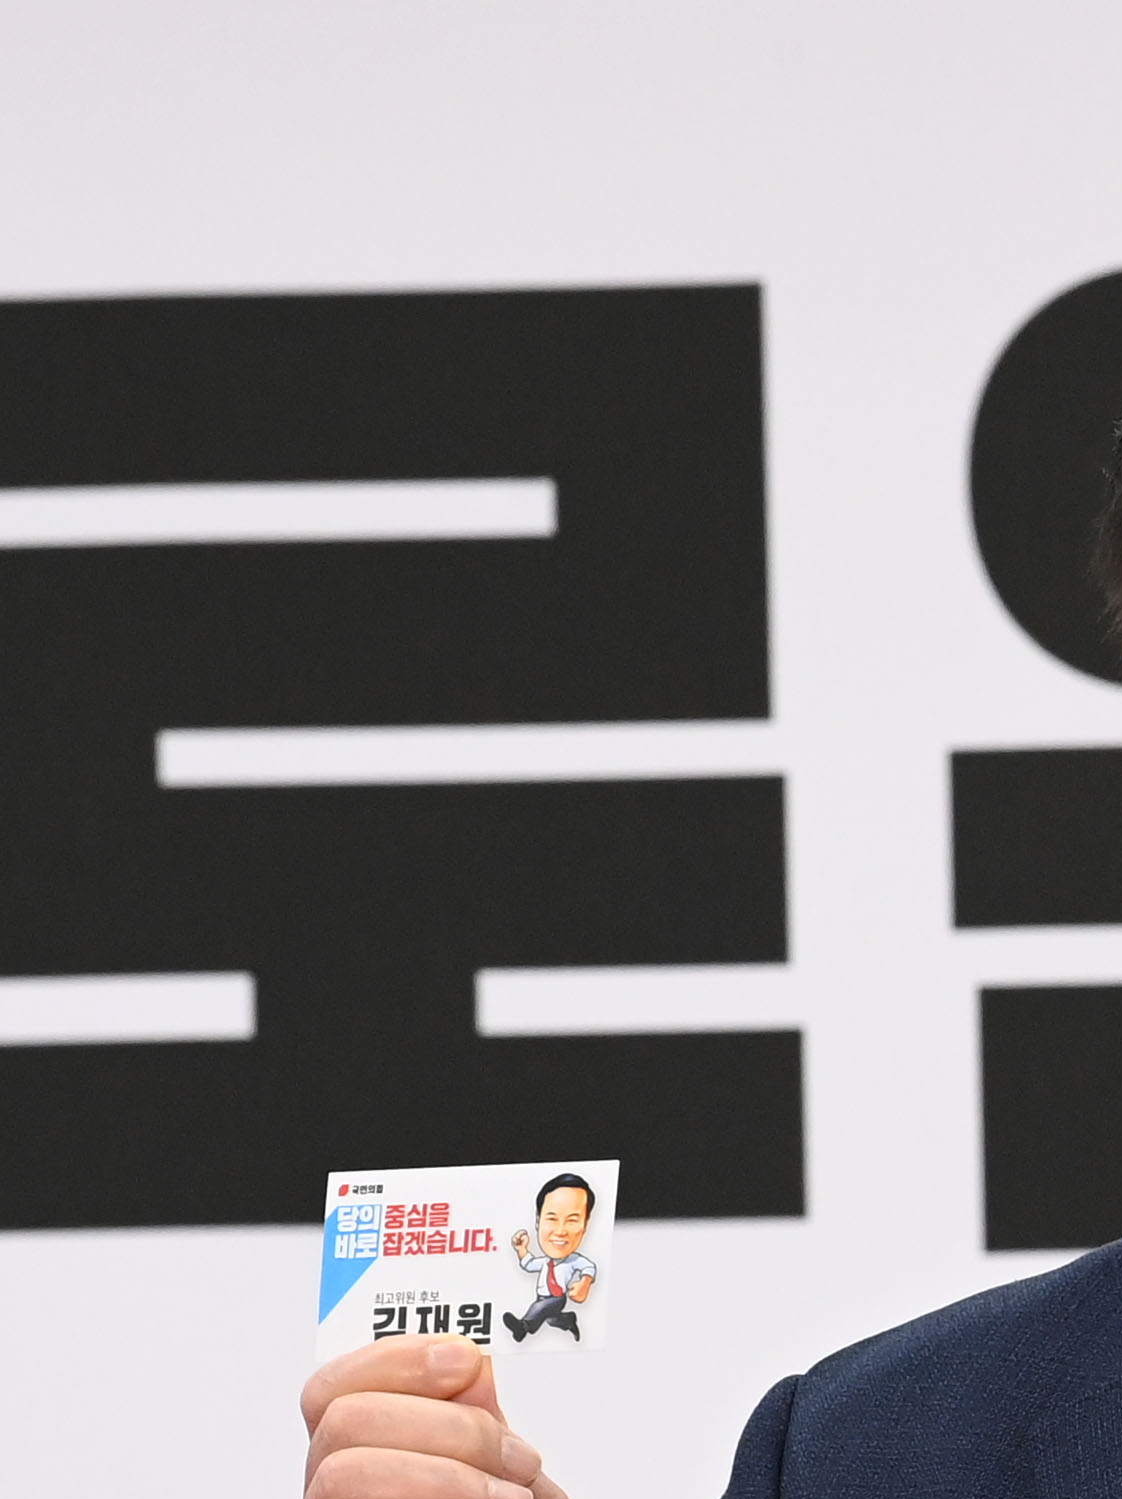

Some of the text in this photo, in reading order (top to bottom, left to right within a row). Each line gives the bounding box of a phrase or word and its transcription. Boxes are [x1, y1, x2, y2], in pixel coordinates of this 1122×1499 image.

[337, 1202, 450, 1232] 당의 중심을
[334, 1228, 498, 1258] 바로 잡겠습니다.
[375, 1290, 440, 1305] 최고위원 후보
